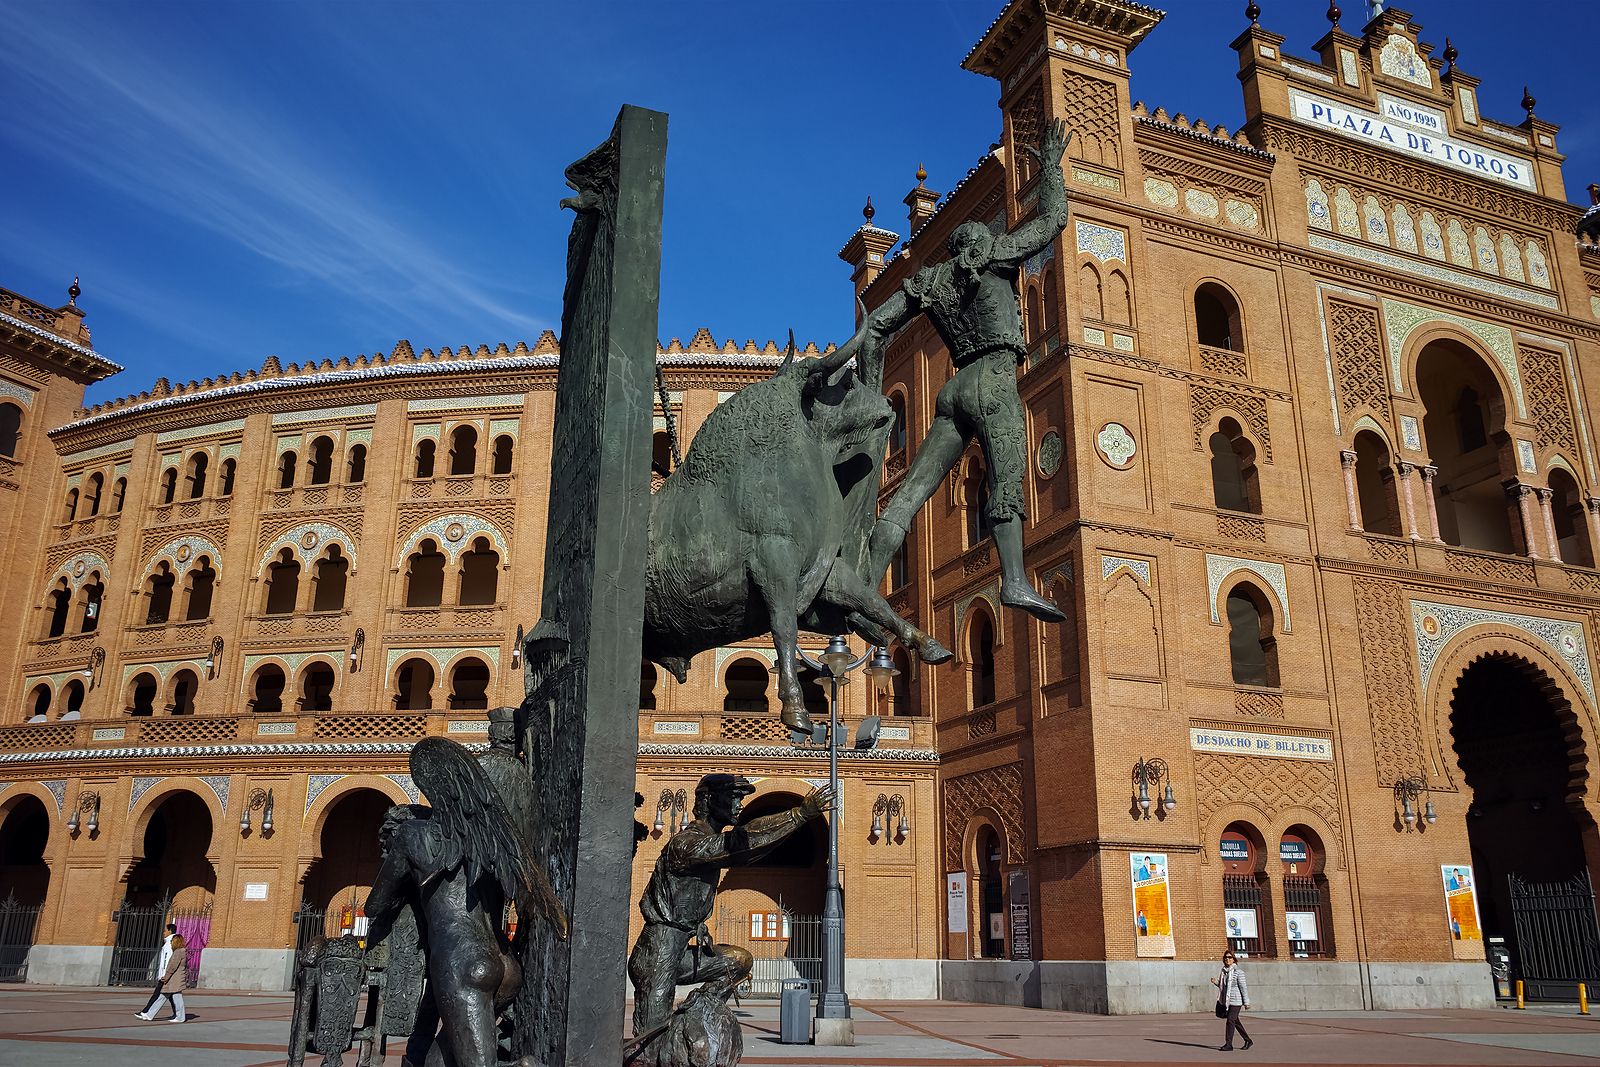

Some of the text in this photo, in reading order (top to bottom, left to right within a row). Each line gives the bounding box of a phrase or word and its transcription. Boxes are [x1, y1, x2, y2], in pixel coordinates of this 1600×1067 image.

[1388, 104, 1437, 128] AÑO 1929
[1311, 103, 1519, 180] PLAZA DE TOROS
[1196, 734, 1325, 753] DESPACHO DE BILLETES
